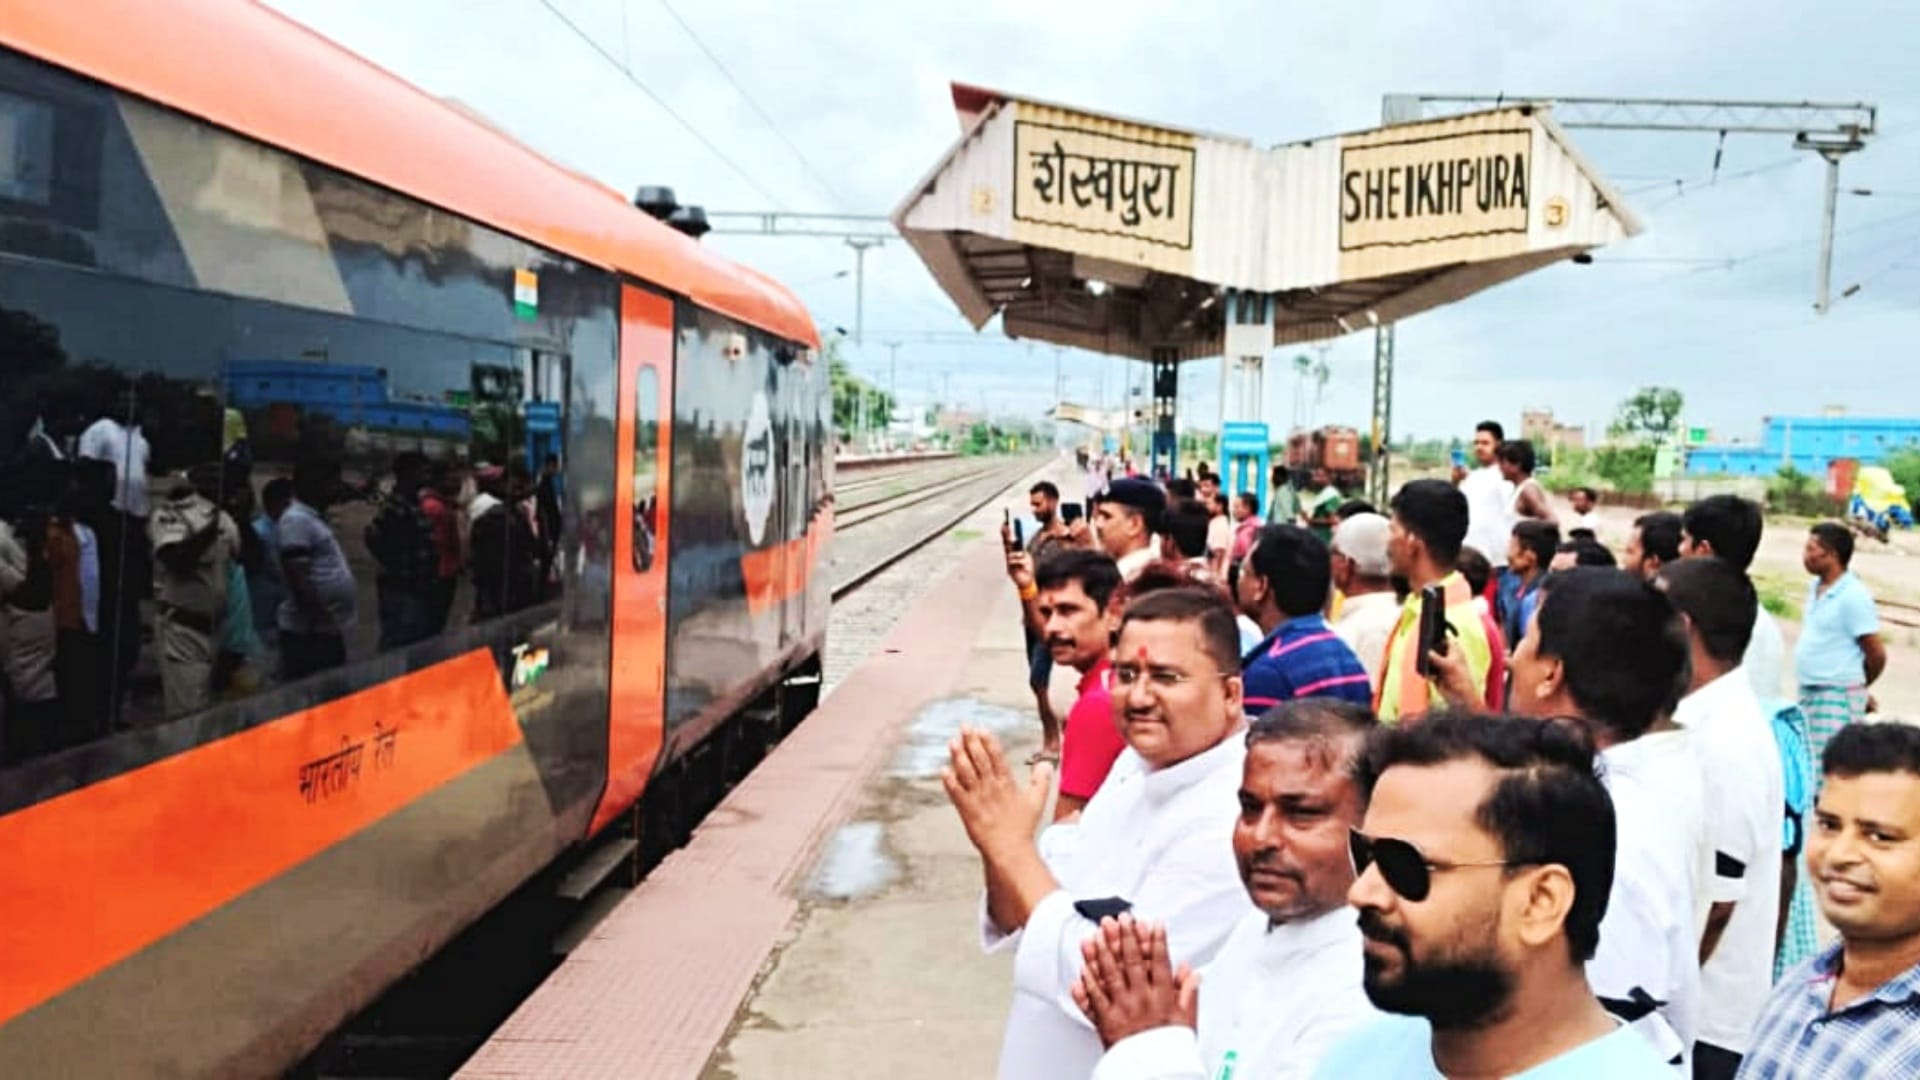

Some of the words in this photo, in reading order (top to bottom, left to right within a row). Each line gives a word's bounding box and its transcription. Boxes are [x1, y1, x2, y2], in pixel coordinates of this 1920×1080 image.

[1343, 153, 1528, 224] SHEIKHPURA
[1547, 204, 1564, 227] 3
[299, 734, 364, 804] भारतीय
